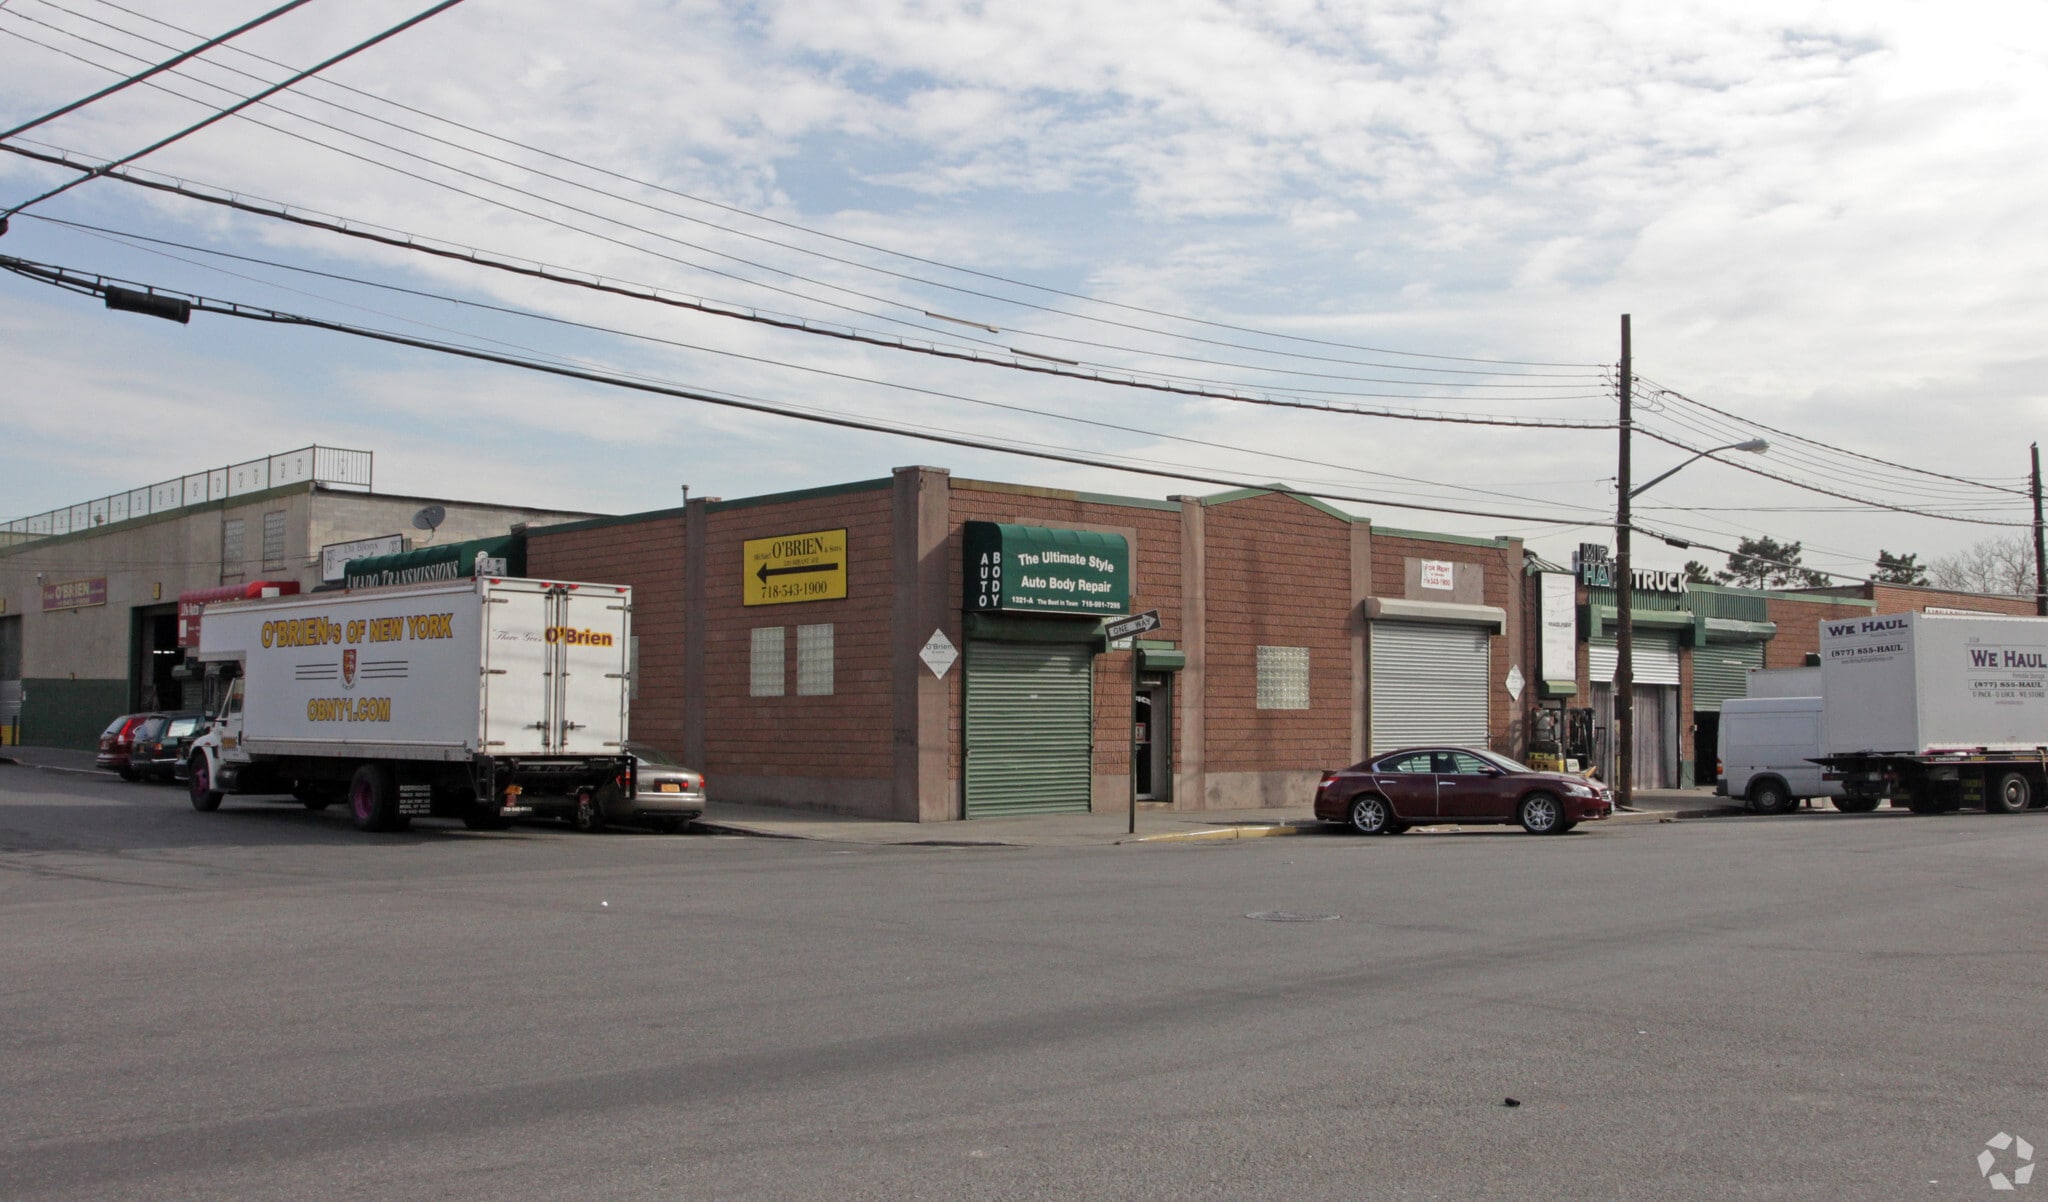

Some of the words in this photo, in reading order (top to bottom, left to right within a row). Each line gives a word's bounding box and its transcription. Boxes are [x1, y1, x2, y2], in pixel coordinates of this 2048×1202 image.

[772, 537, 824, 559] O'BRIEN
[382, 560, 459, 585] TRANSMISSIONS
[1018, 553, 1039, 566] The
[1042, 552, 1086, 565] Ultimate
[1088, 556, 1114, 572] Style
[1021, 576, 1046, 588] Auto
[1049, 577, 1075, 592] Body
[1078, 579, 1112, 594] Repair
[346, 619, 367, 644] OF
[369, 616, 404, 643] NEW
[406, 612, 454, 640] YORK
[1113, 624, 1129, 635] ONE
[1135, 616, 1151, 629] WAY
[545, 626, 613, 647] O'Brien
[307, 696, 391, 722] OBNY1.COM
